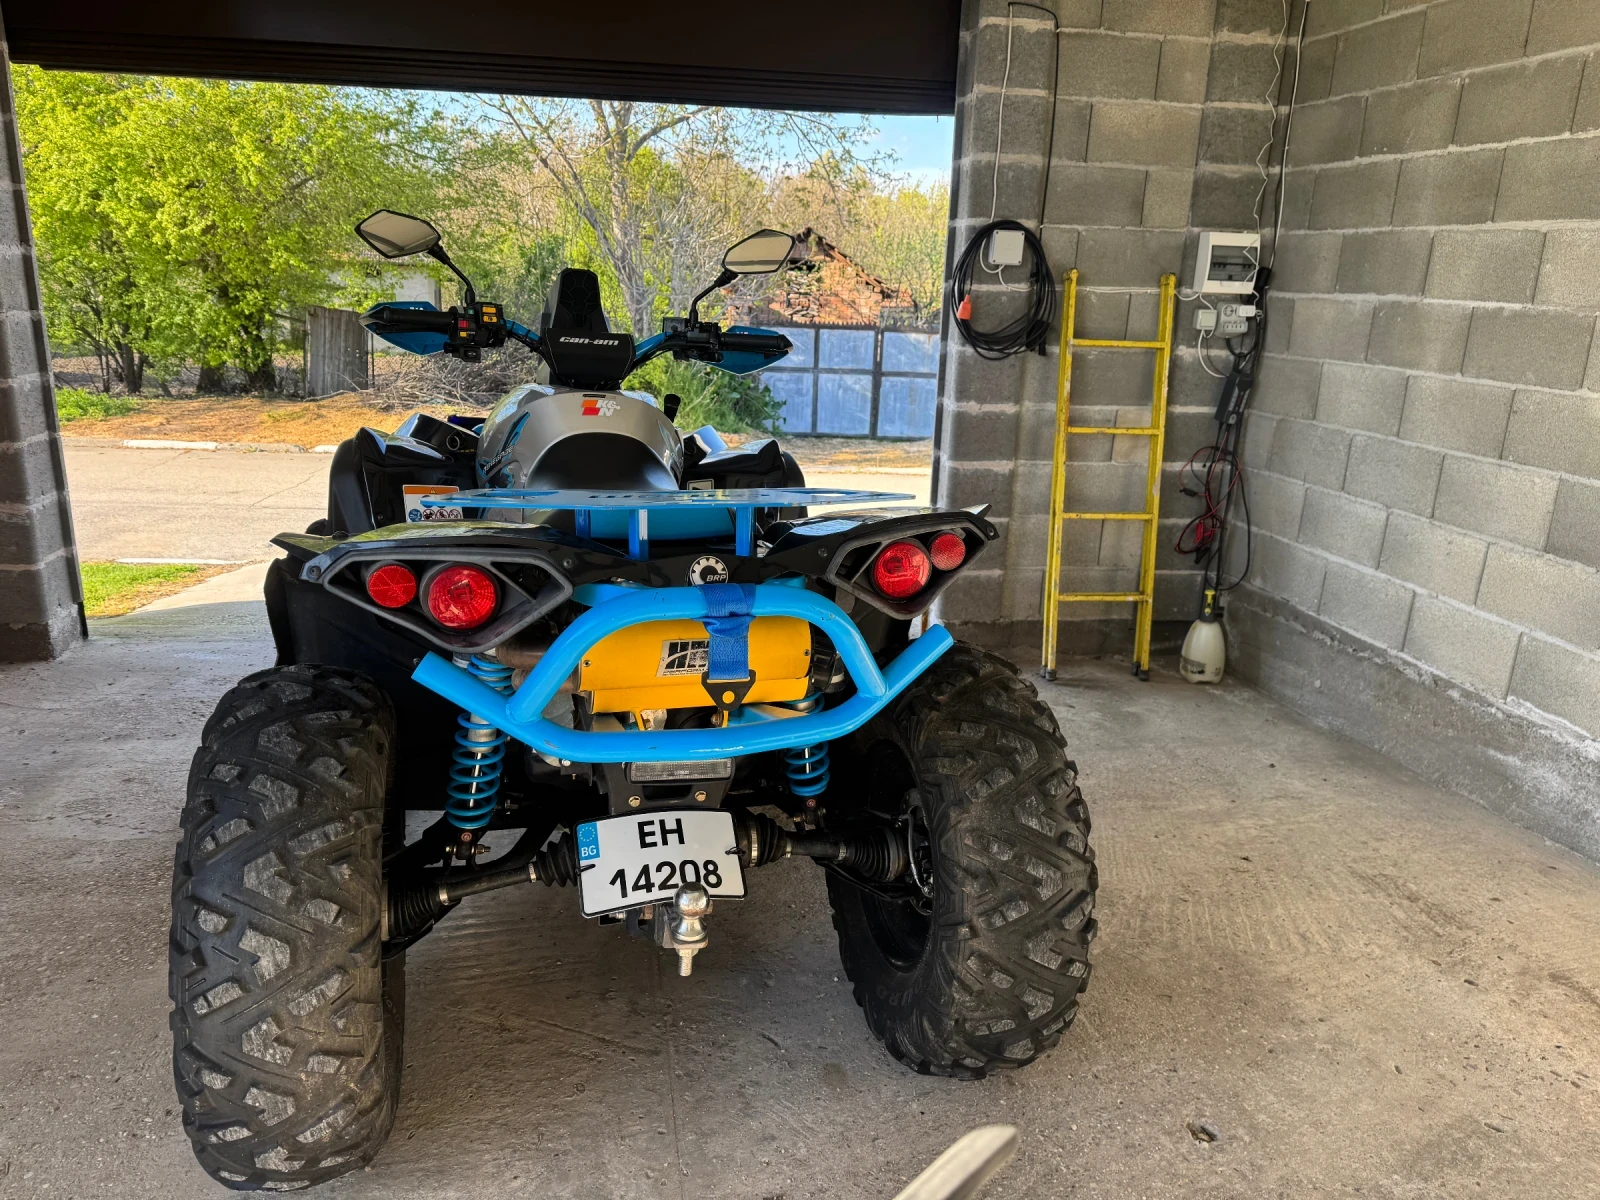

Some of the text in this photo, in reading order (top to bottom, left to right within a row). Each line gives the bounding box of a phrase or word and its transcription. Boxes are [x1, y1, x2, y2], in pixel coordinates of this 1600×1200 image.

[706, 574, 727, 582] BRP
[637, 818, 685, 849] EH
[581, 845, 597, 857] BG
[609, 859, 723, 899] 14208
